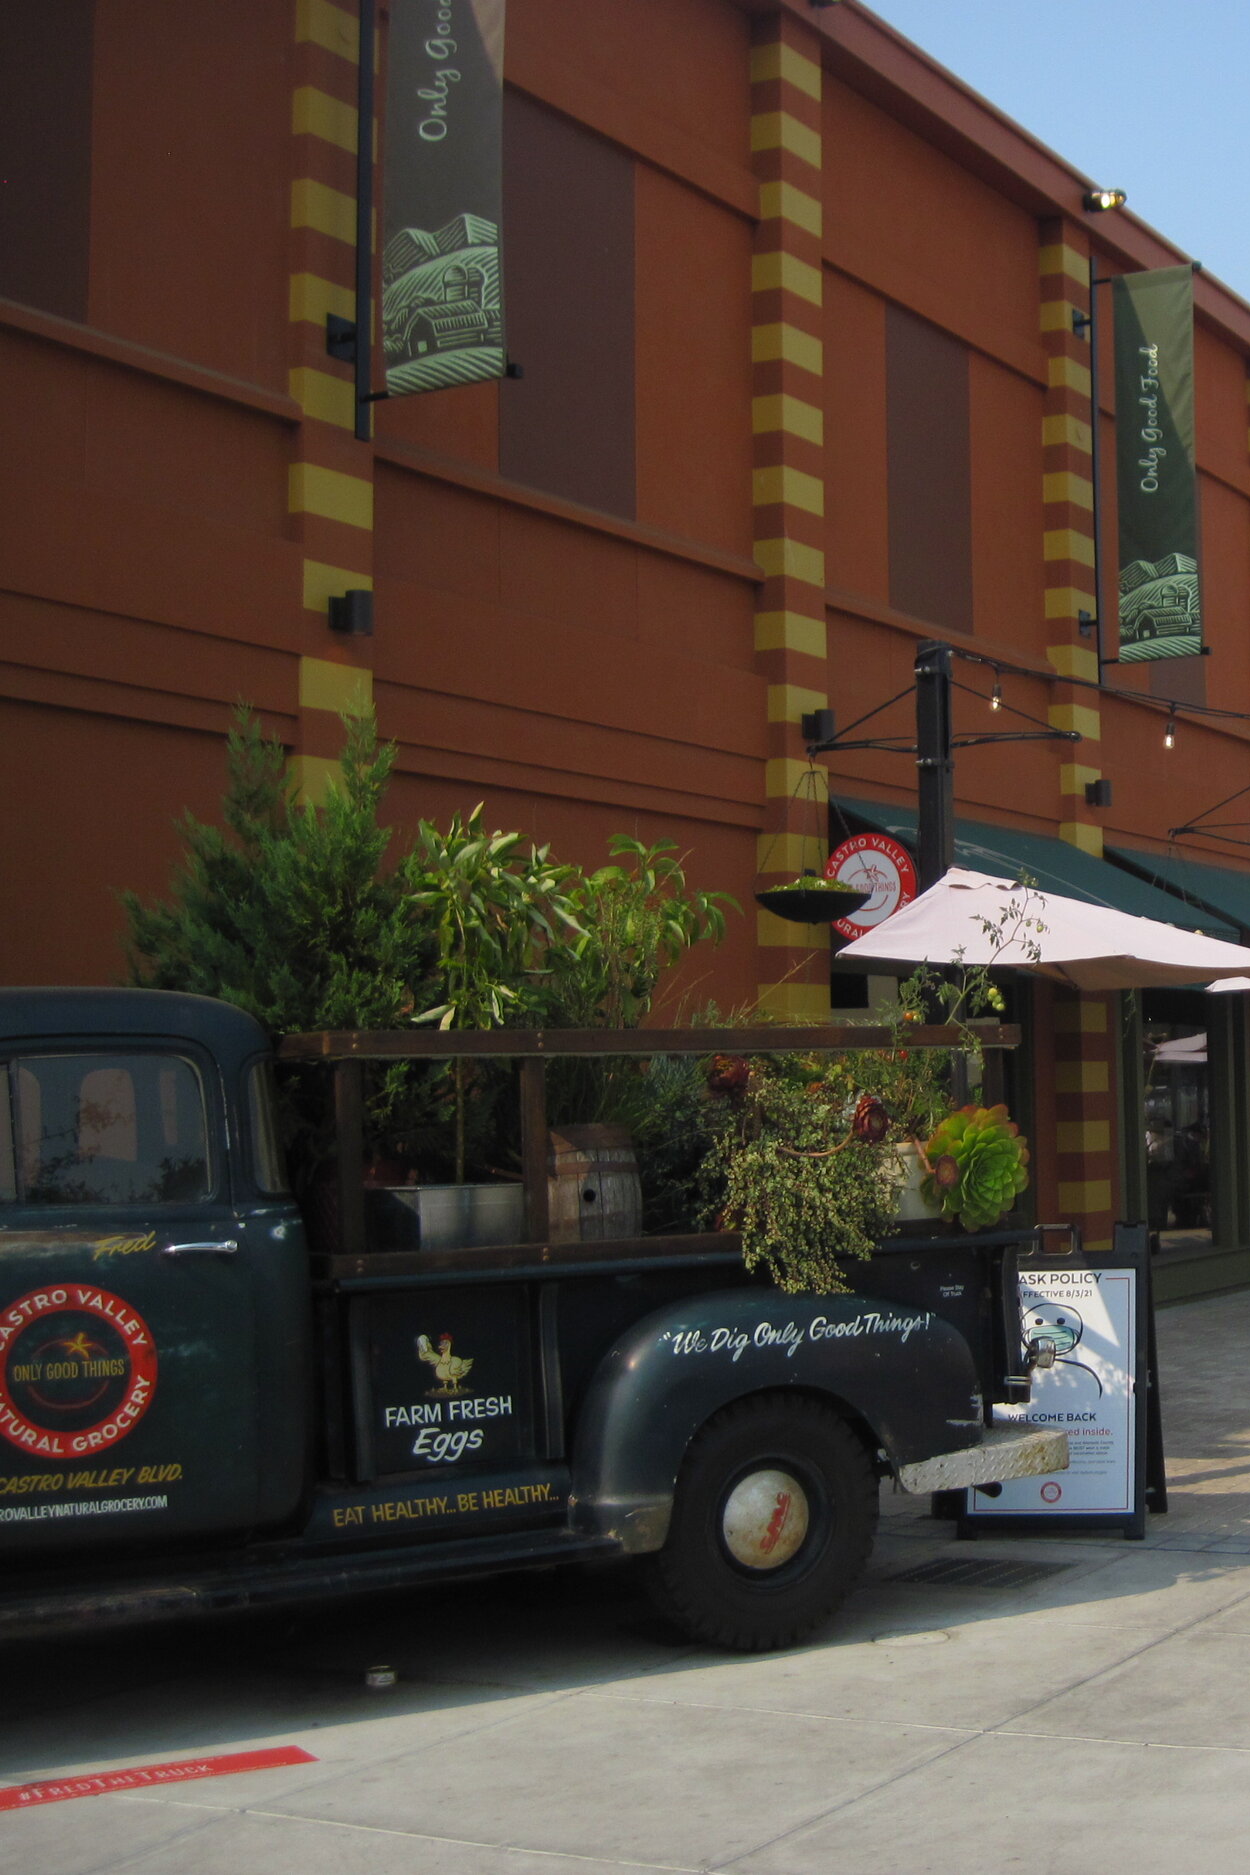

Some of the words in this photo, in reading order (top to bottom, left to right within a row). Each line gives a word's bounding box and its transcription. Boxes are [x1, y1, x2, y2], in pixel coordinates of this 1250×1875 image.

[417, 69, 461, 142] Only
[1139, 343, 1159, 392] Food
[1139, 393, 1163, 441] Good
[1138, 447, 1166, 492] Only
[826, 838, 867, 877] CASTRO
[872, 837, 909, 873] VALLEY
[92, 1230, 157, 1261] Fred
[1018, 1273, 1047, 1285] ASK
[1050, 1272, 1102, 1285] POLICY
[1066, 1289, 1093, 1299] 8/3/21
[77, 1289, 149, 1346] VALLEY
[711, 1327, 751, 1361] Dig
[754, 1321, 804, 1357] Only
[809, 1316, 864, 1341] Good
[14, 1363, 43, 1382] ONLY
[47, 1361, 78, 1380] GOOD
[82, 1358, 125, 1377] THINGS
[72, 1375, 150, 1452] GROCERY
[385, 1402, 442, 1428] FARM
[449, 1395, 513, 1421] FRESH
[1008, 1413, 1064, 1422] WELCOME
[1066, 1412, 1097, 1422] BACK
[413, 1427, 484, 1461] Eggs
[1082, 1427, 1113, 1436] inside.
[67, 1467, 135, 1490] VALLEY
[138, 1463, 183, 1484] BLVD.
[332, 1506, 365, 1527] EAT
[457, 1491, 479, 1513] BE
